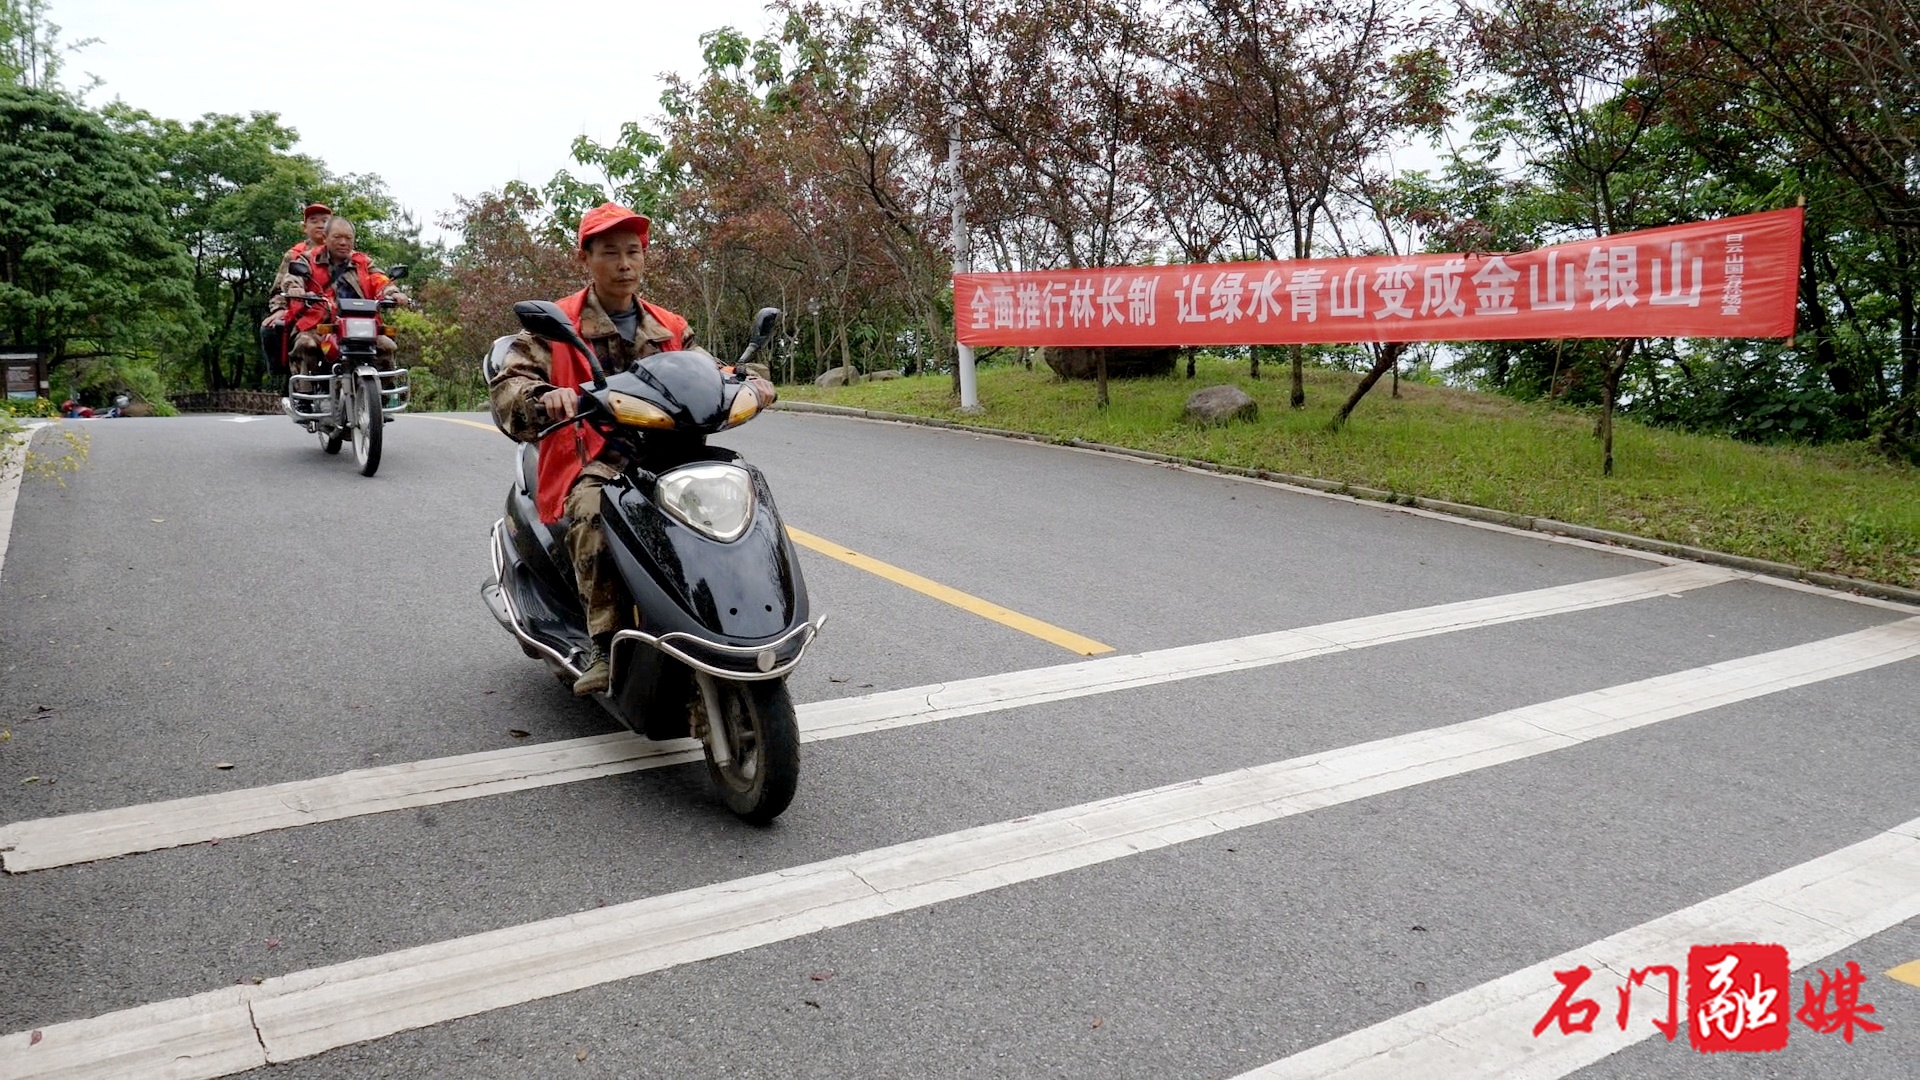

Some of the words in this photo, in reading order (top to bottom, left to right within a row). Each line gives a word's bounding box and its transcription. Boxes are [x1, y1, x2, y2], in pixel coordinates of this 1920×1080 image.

[970, 275, 1160, 330] 全面推行林长制
[1174, 242, 1703, 325] 让绿水青山变成金山银山
